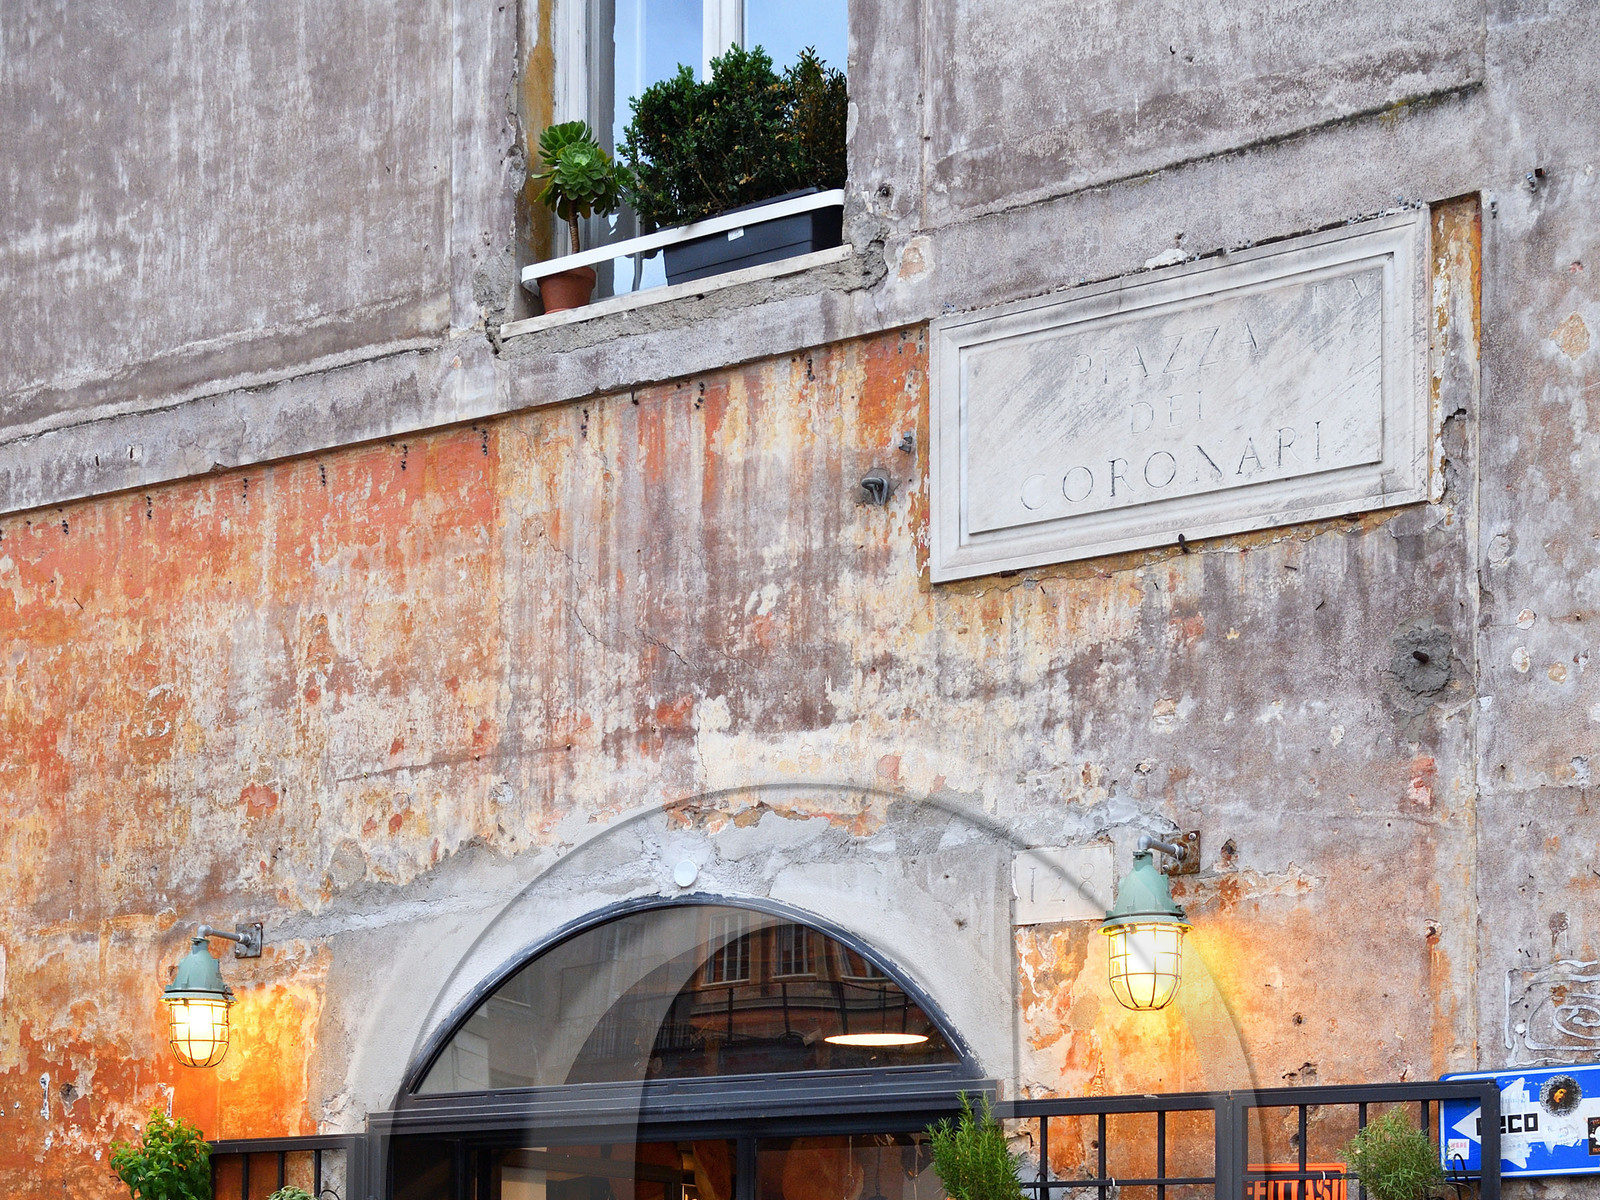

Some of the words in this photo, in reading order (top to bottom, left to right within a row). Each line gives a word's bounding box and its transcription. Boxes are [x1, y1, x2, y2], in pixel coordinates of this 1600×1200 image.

[1074, 322, 1261, 385] PIAZZA
[1130, 391, 1203, 435] DEI
[1020, 421, 1322, 511] CORONARI
[1029, 863, 1095, 904] 128
